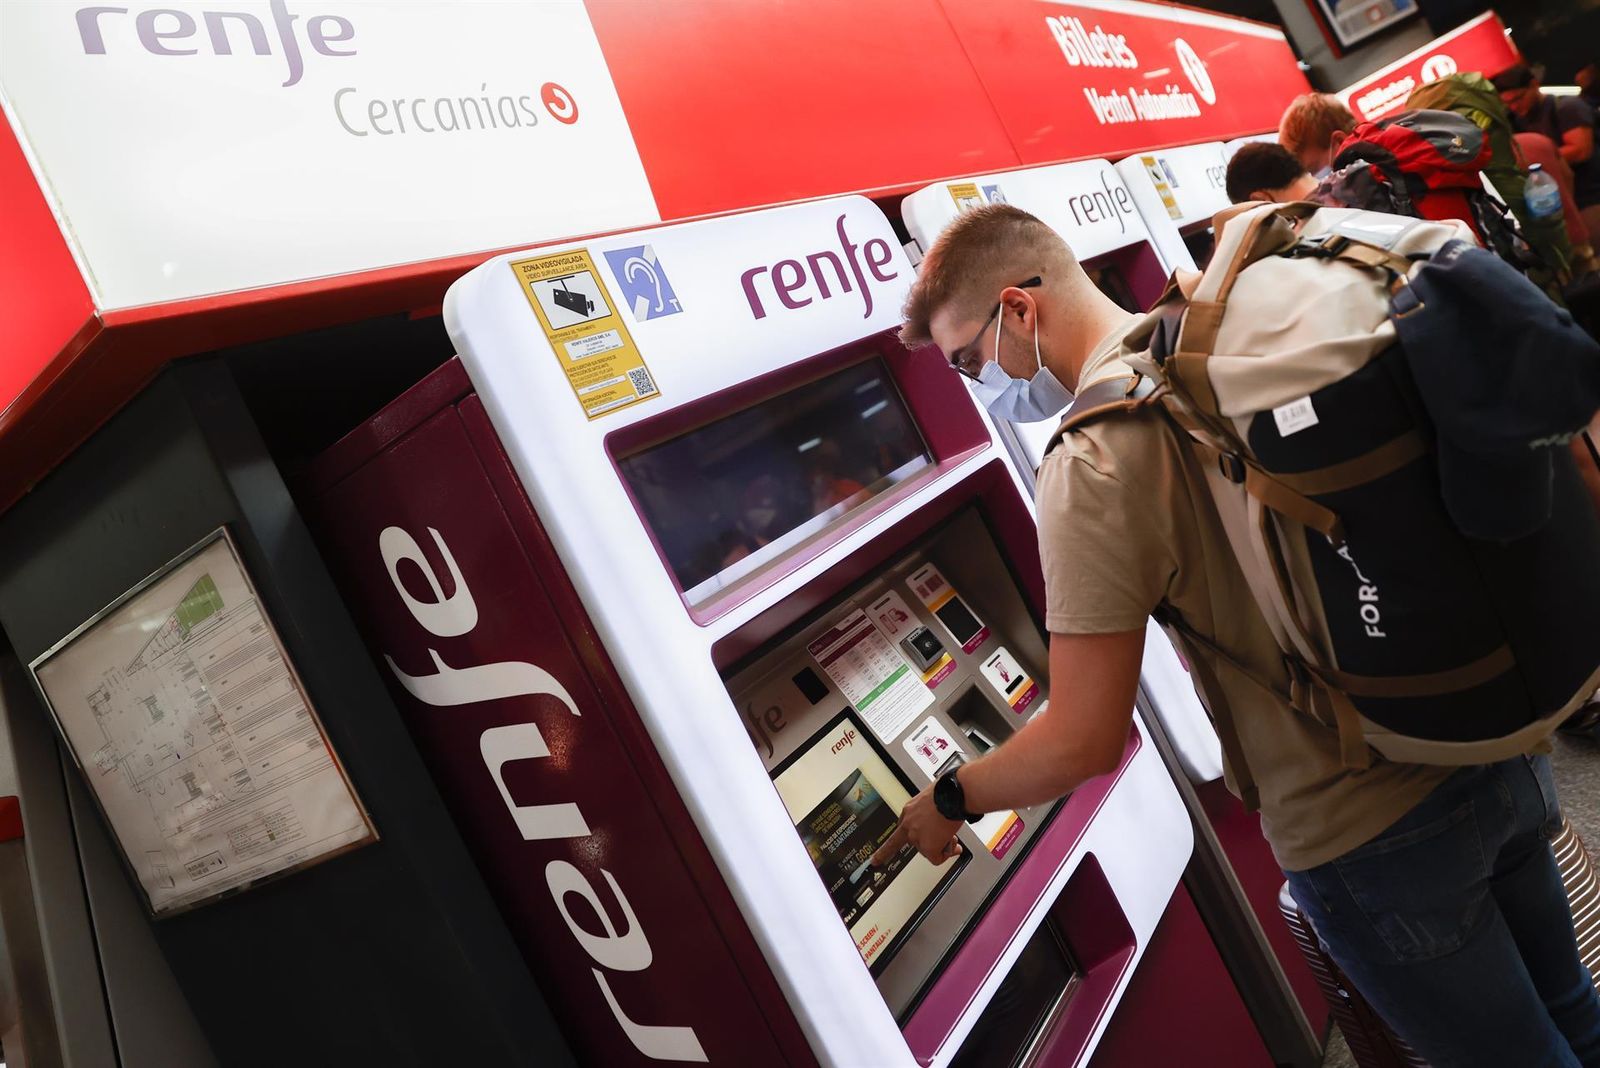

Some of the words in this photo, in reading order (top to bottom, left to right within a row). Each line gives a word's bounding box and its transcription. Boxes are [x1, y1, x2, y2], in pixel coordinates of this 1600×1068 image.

[75, 0, 357, 87] renfe
[1046, 16, 1138, 69] Billetes
[334, 83, 538, 137] Cercanías
[1083, 87, 1137, 124] Venta
[1068, 170, 1131, 234] renfe
[522, 264, 540, 273] ZONA
[539, 255, 584, 269] VIDEOVIGILADA
[541, 265, 575, 277] SURVEILLANCE
[741, 214, 898, 320] renfe
[830, 728, 856, 755] renfe
[379, 526, 709, 1063] renfe
[860, 927, 877, 947] SCREEN
[864, 934, 886, 960] PANTALLA
